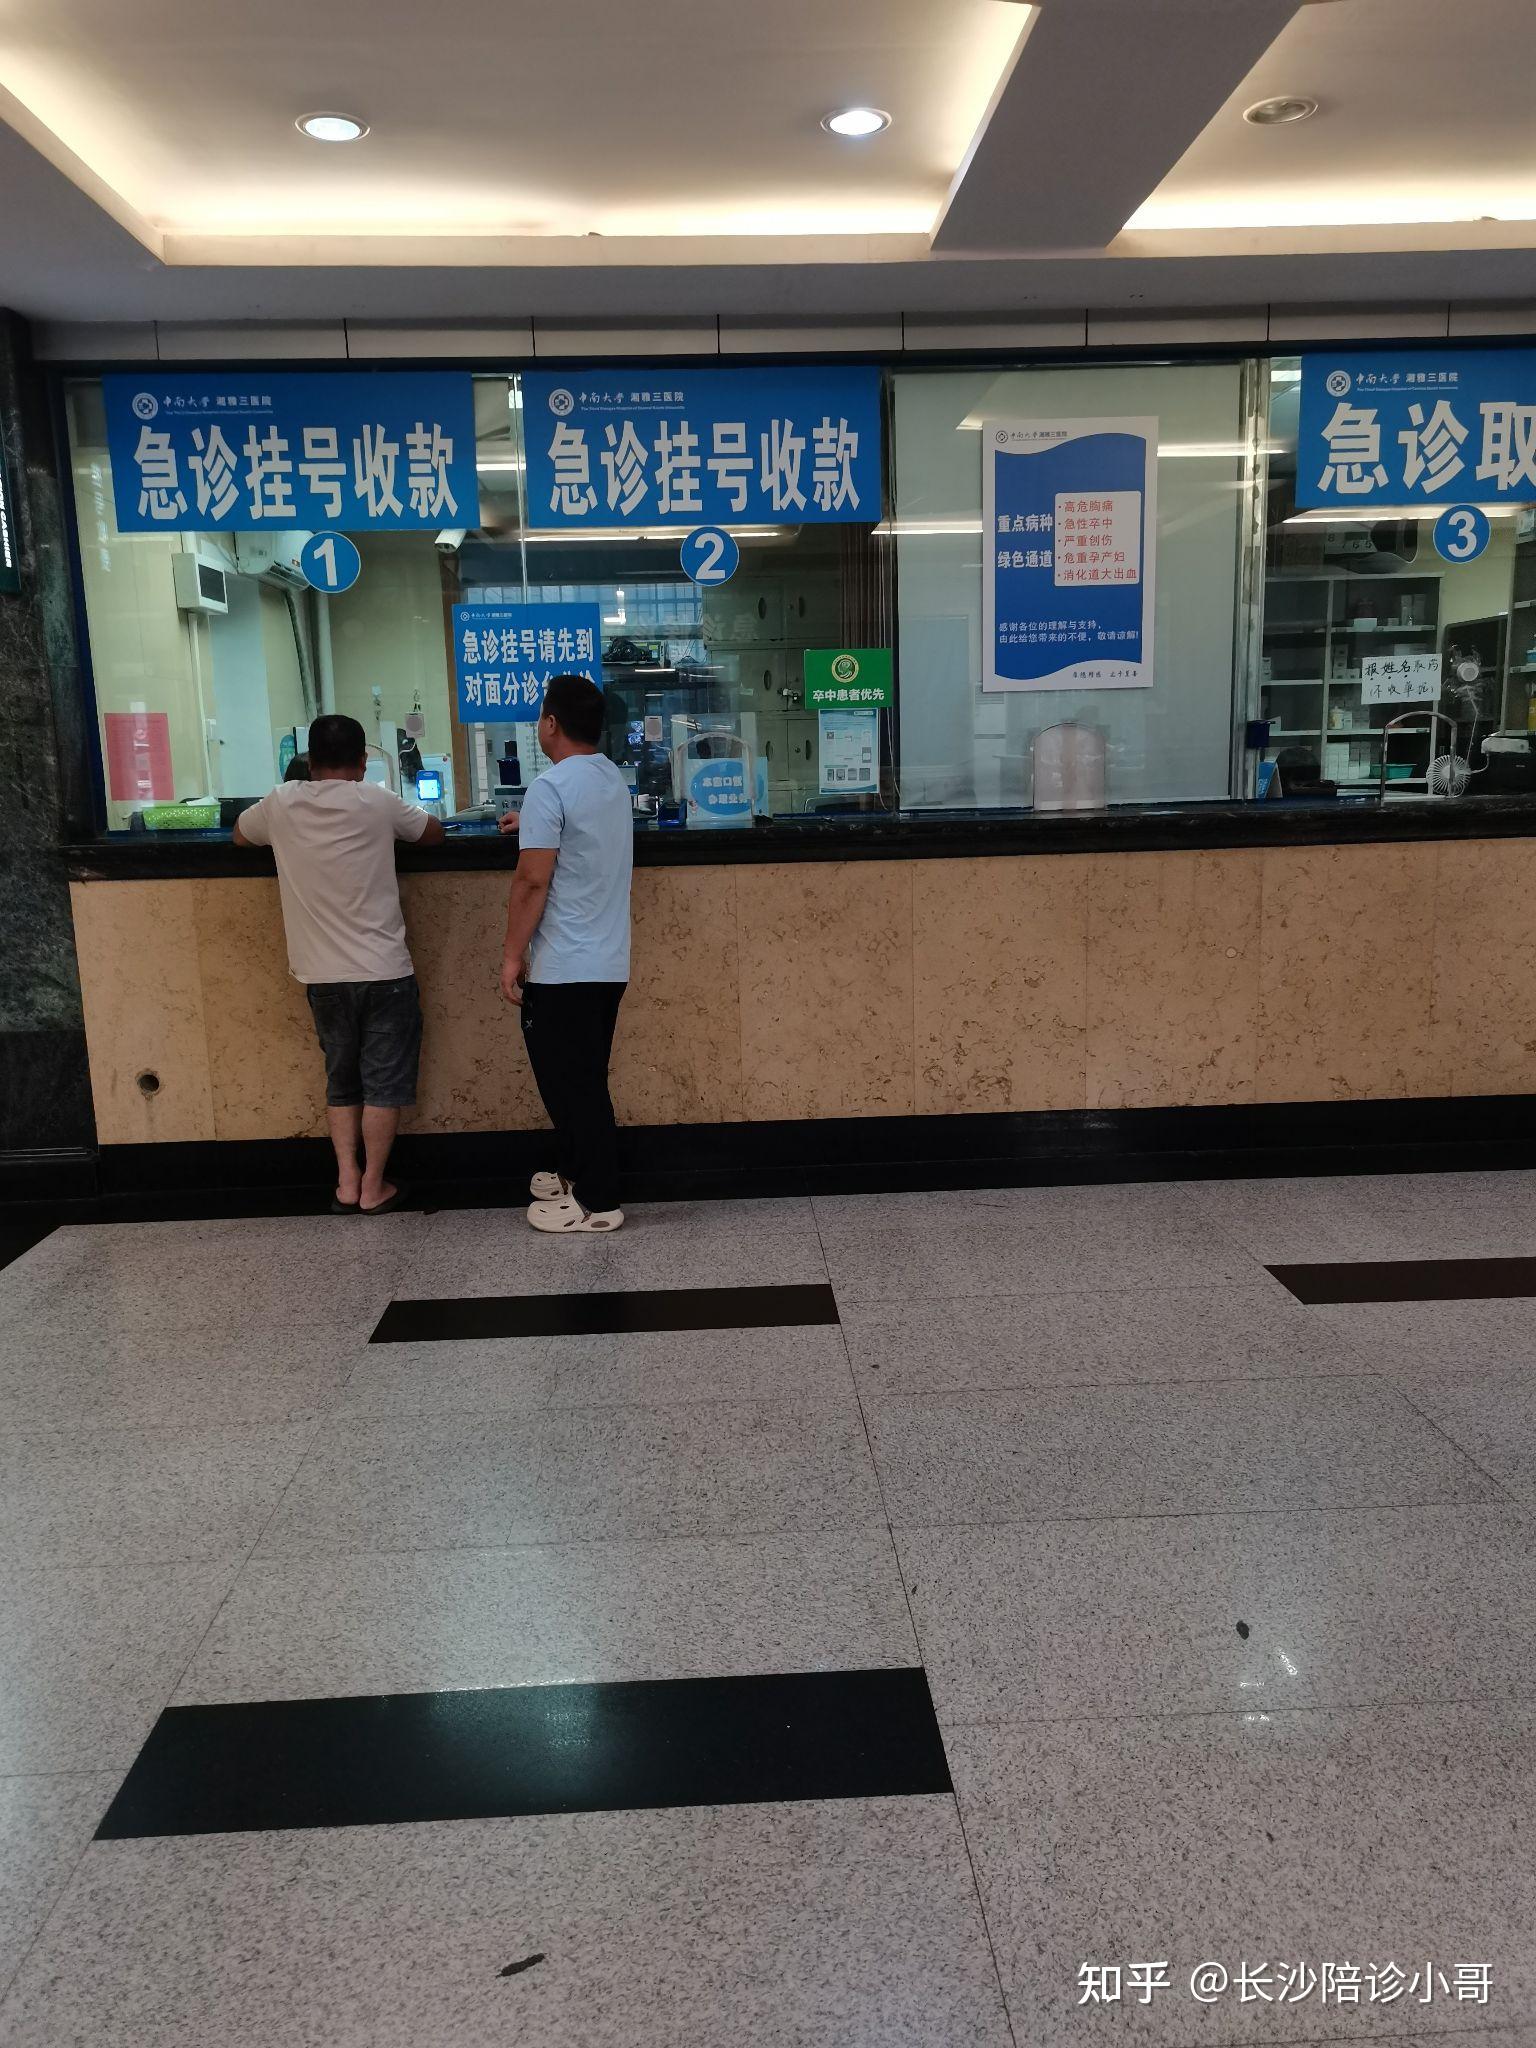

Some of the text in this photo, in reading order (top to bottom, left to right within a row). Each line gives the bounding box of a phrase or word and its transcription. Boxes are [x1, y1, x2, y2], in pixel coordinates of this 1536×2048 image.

[579, 391, 624, 404] 中南大学
[1317, 400, 1536, 494] 急诊取
[133, 422, 459, 521] 急诊挂号收款
[548, 416, 861, 516] 急诊挂号收款
[1064, 501, 1113, 513] 高危胸痛
[997, 514, 1053, 533] 重点病种
[1064, 518, 1113, 530] 急性卒中
[1064, 535, 1112, 548] 严重创伤
[1447, 511, 1478, 558] 3
[313, 538, 338, 586] 1
[694, 533, 726, 580] 2
[997, 550, 1053, 569] 绿色通道
[1063, 551, 1126, 565] 危重孕产妇
[1063, 568, 1138, 581] 消化道大出血
[463, 627, 594, 664] 急诊挂号请先到
[812, 687, 885, 702] 卒中患者优先
